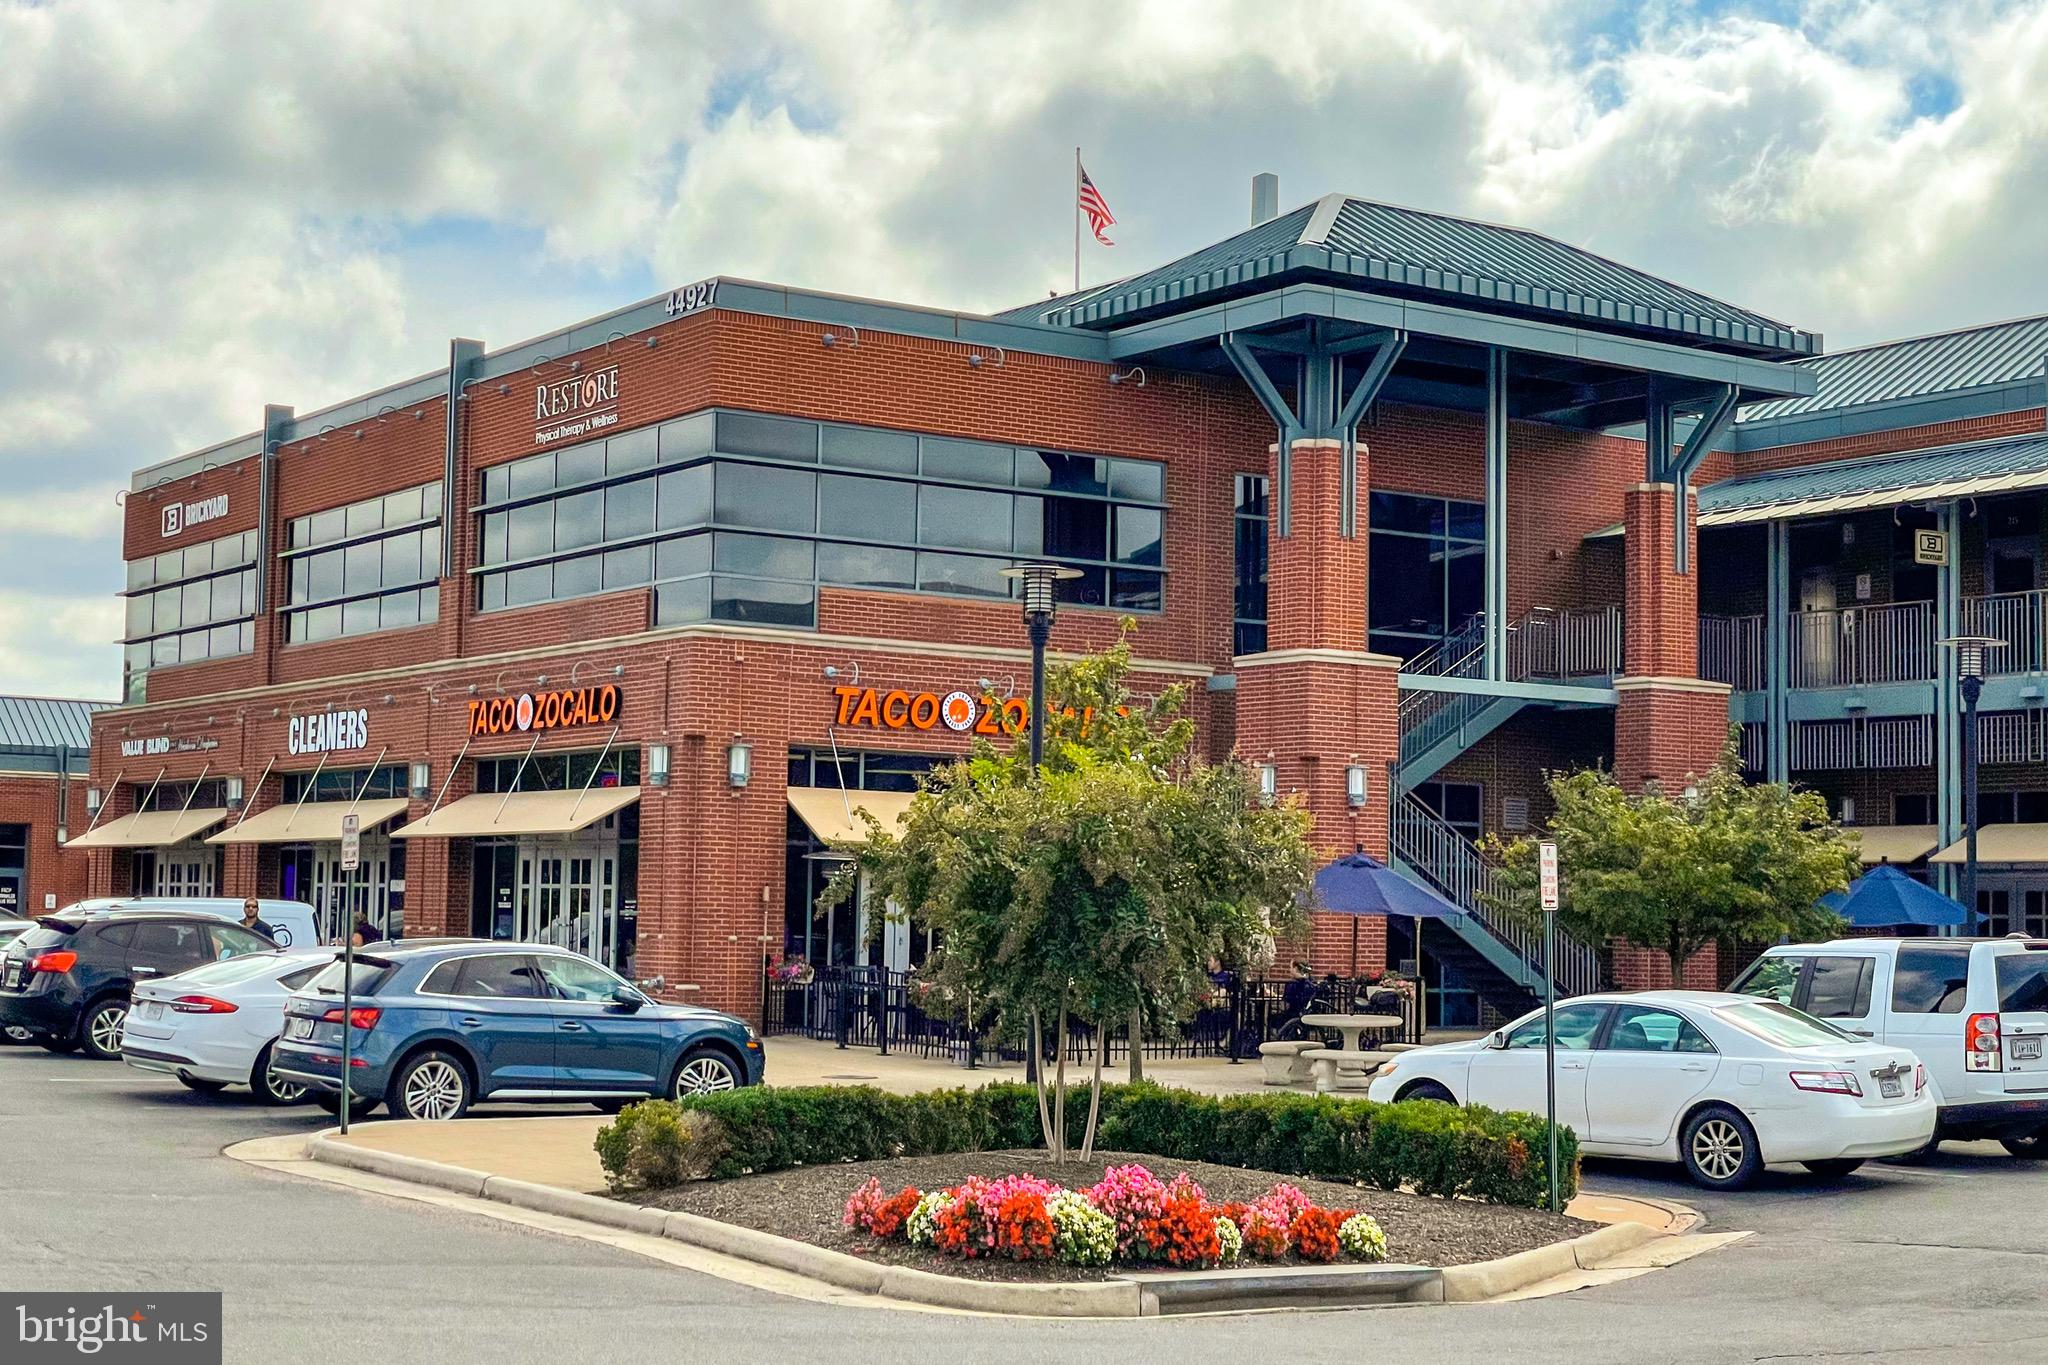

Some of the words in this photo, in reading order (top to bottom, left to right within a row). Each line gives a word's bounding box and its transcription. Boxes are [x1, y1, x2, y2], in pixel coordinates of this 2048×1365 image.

[665, 279, 719, 315] 44927
[536, 369, 619, 420] RESTORE
[535, 428, 560, 444] Physical
[560, 422, 586, 437] Therapy
[586, 419, 591, 431] &
[591, 414, 618, 429] Wellness
[185, 494, 228, 526] BRICKYARD
[468, 697, 515, 735] TACO
[532, 685, 618, 729] ZOCALO
[834, 686, 940, 730] TACO
[121, 739, 144, 757] VALUE
[146, 737, 170, 755] BLIND
[288, 708, 368, 756] CLEANERS
